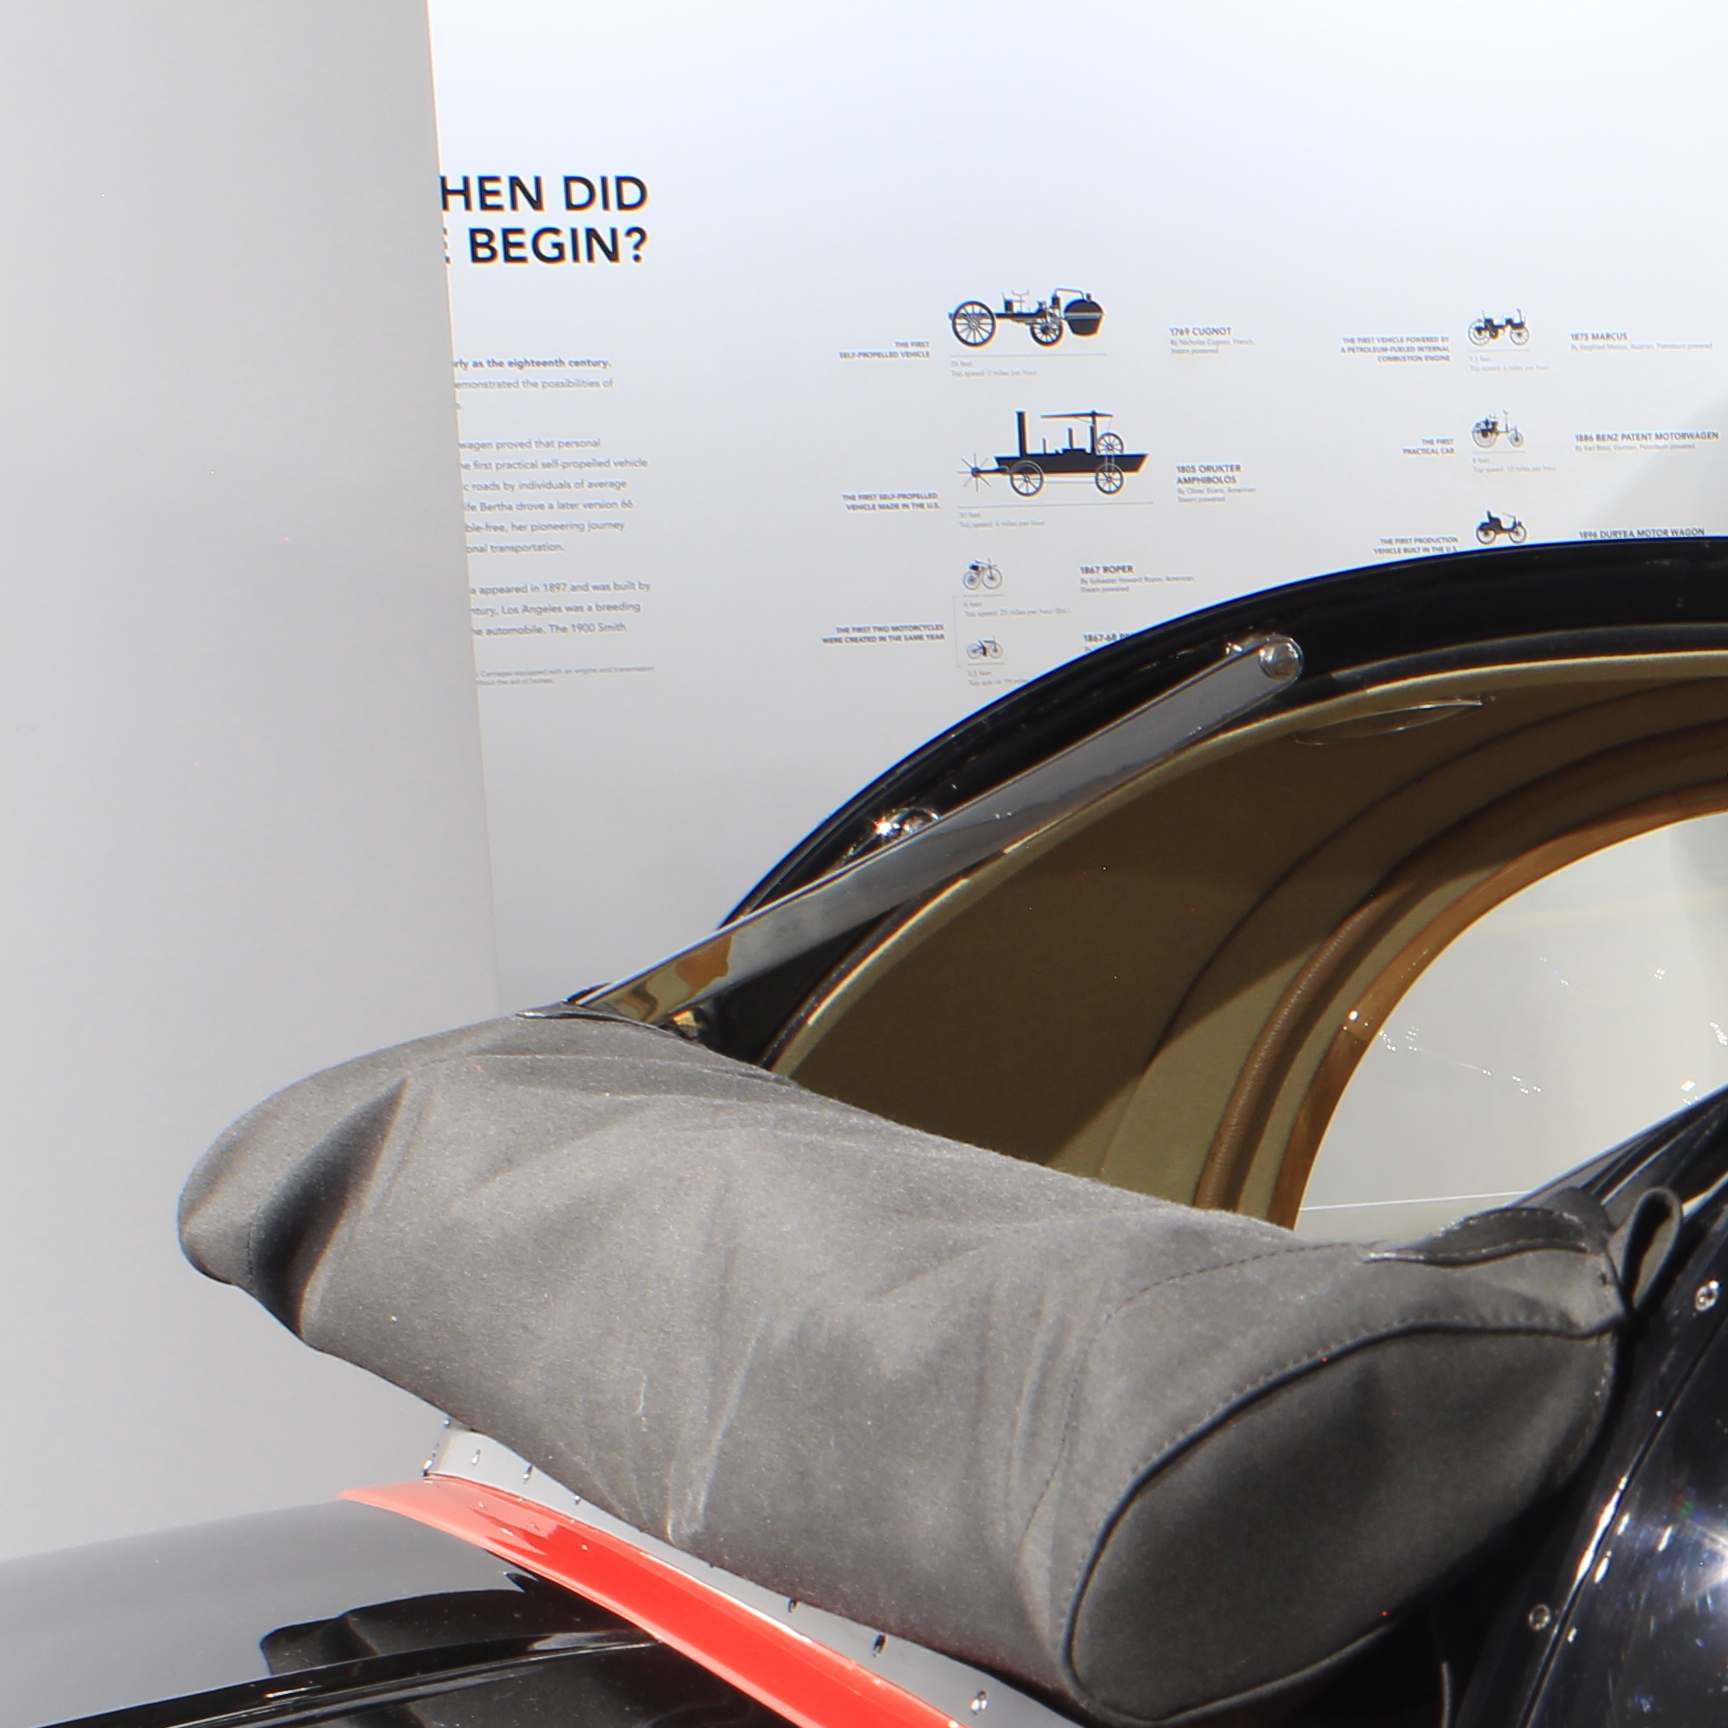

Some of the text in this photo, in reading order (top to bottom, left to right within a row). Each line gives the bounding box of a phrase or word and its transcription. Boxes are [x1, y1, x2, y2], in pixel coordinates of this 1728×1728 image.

[440, 175, 648, 212] HEN DID
[469, 226, 648, 265] BEGIN?
[1192, 326, 1232, 336] CUGNOT
[895, 340, 930, 349] THE FIRST
[839, 350, 930, 359] SELF-PROPELLED VEHICLE
[472, 361, 484, 369] as
[487, 359, 504, 368] the
[508, 358, 566, 370] eighteenth
[455, 378, 614, 391] emonstrated the possibilities of
[1596, 433, 1619, 443] BENZ
[1621, 433, 1652, 442] PATENT
[1655, 431, 1720, 441] MOTORWAGEN
[460, 437, 601, 452] wagen proved that personal
[473, 459, 492, 470] first
[495, 459, 539, 472] practical
[541, 459, 611, 471] self-propelled
[613, 457, 648, 468] vehicle
[472, 481, 500, 491] roads
[503, 481, 515, 493] by
[519, 480, 573, 491] individuals
[574, 479, 585, 489] of
[587, 481, 628, 491] average
[858, 493, 877, 501] FIRST
[879, 492, 938, 501] SELF-PROPELLED
[480, 501, 514, 511] Bertha
[516, 501, 545, 511] drove
[557, 500, 579, 510] later
[582, 501, 619, 510] version
[621, 499, 634, 509] 66
[846, 503, 876, 511] VEHICLE
[466, 521, 624, 534] ble-free, her pioneering journey
[1600, 530, 1636, 539] DURYEA
[1637, 528, 1668, 538] MOTOR
[1670, 527, 1706, 537] WAGON
[466, 544, 488, 554] onal
[479, 584, 528, 597] appeared
[530, 583, 540, 592] in
[543, 582, 568, 593] 1897
[570, 582, 590, 592] and
[592, 583, 611, 592] was
[613, 580, 636, 591] built
[638, 580, 650, 592] by
[501, 605, 519, 615] Los
[521, 603, 562, 616] Angeles
[565, 605, 585, 613] was
[595, 601, 641, 614] breeding
[549, 622, 568, 633] The
[571, 621, 596, 633] 1900
[598, 620, 627, 632] Smith
[836, 626, 850, 634] THE
[872, 625, 891, 633] TWO
[891, 624, 944, 633] MOTORCYCLES
[822, 636, 843, 644] WERE
[879, 635, 887, 643] IN
[904, 634, 927, 642] SAME
[926, 633, 945, 641] YEAR
